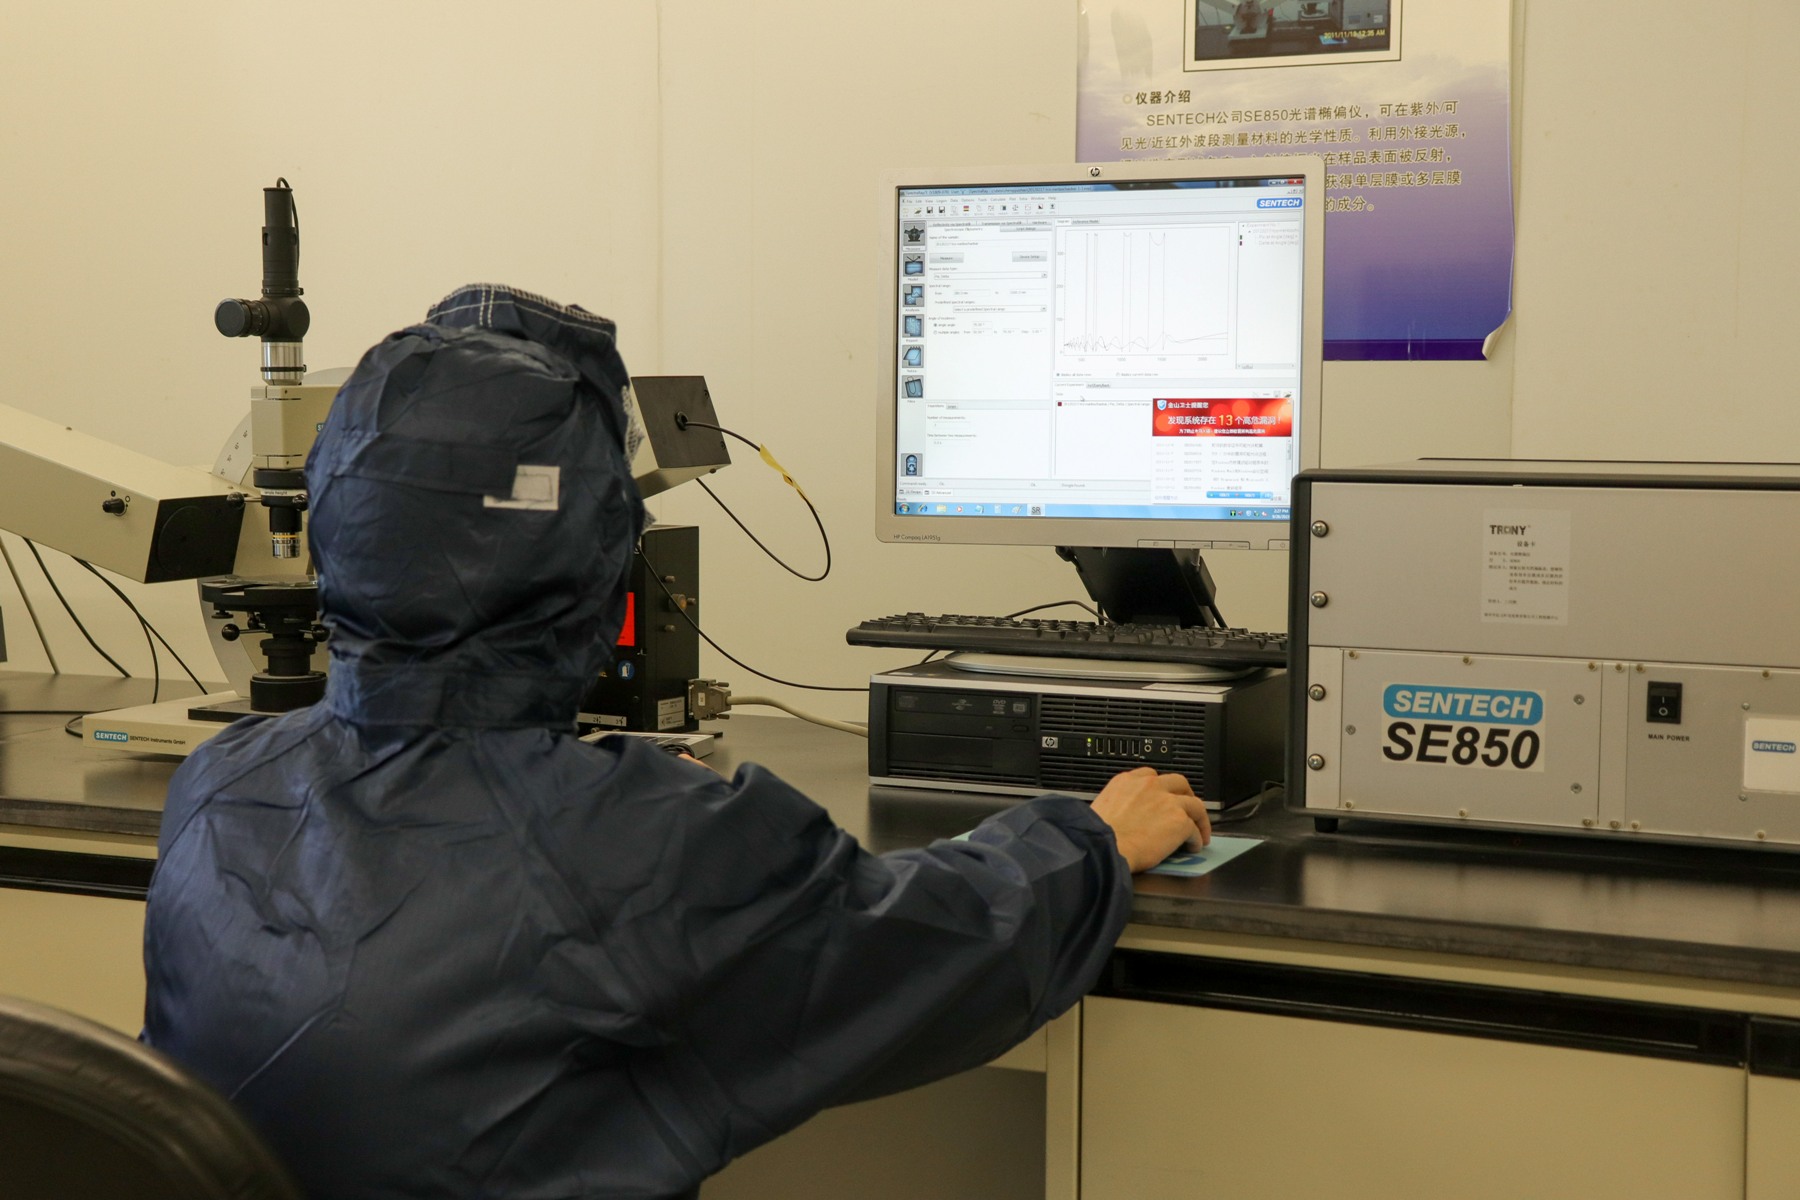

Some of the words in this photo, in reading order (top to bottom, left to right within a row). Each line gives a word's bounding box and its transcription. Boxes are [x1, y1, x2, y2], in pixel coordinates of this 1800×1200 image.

[1135, 90, 1191, 105] 仪器介绍
[1259, 199, 1300, 208] SENTECH
[1168, 416, 1216, 425] 发现系统存在
[1219, 414, 1233, 426] 13
[1031, 505, 1042, 515] SR
[1489, 524, 1527, 536] TRONY
[1393, 690, 1534, 719] SENTECH
[95, 732, 128, 741] SENTECH
[1382, 721, 1541, 769] SE850
[1753, 742, 1796, 751] SENTECH
